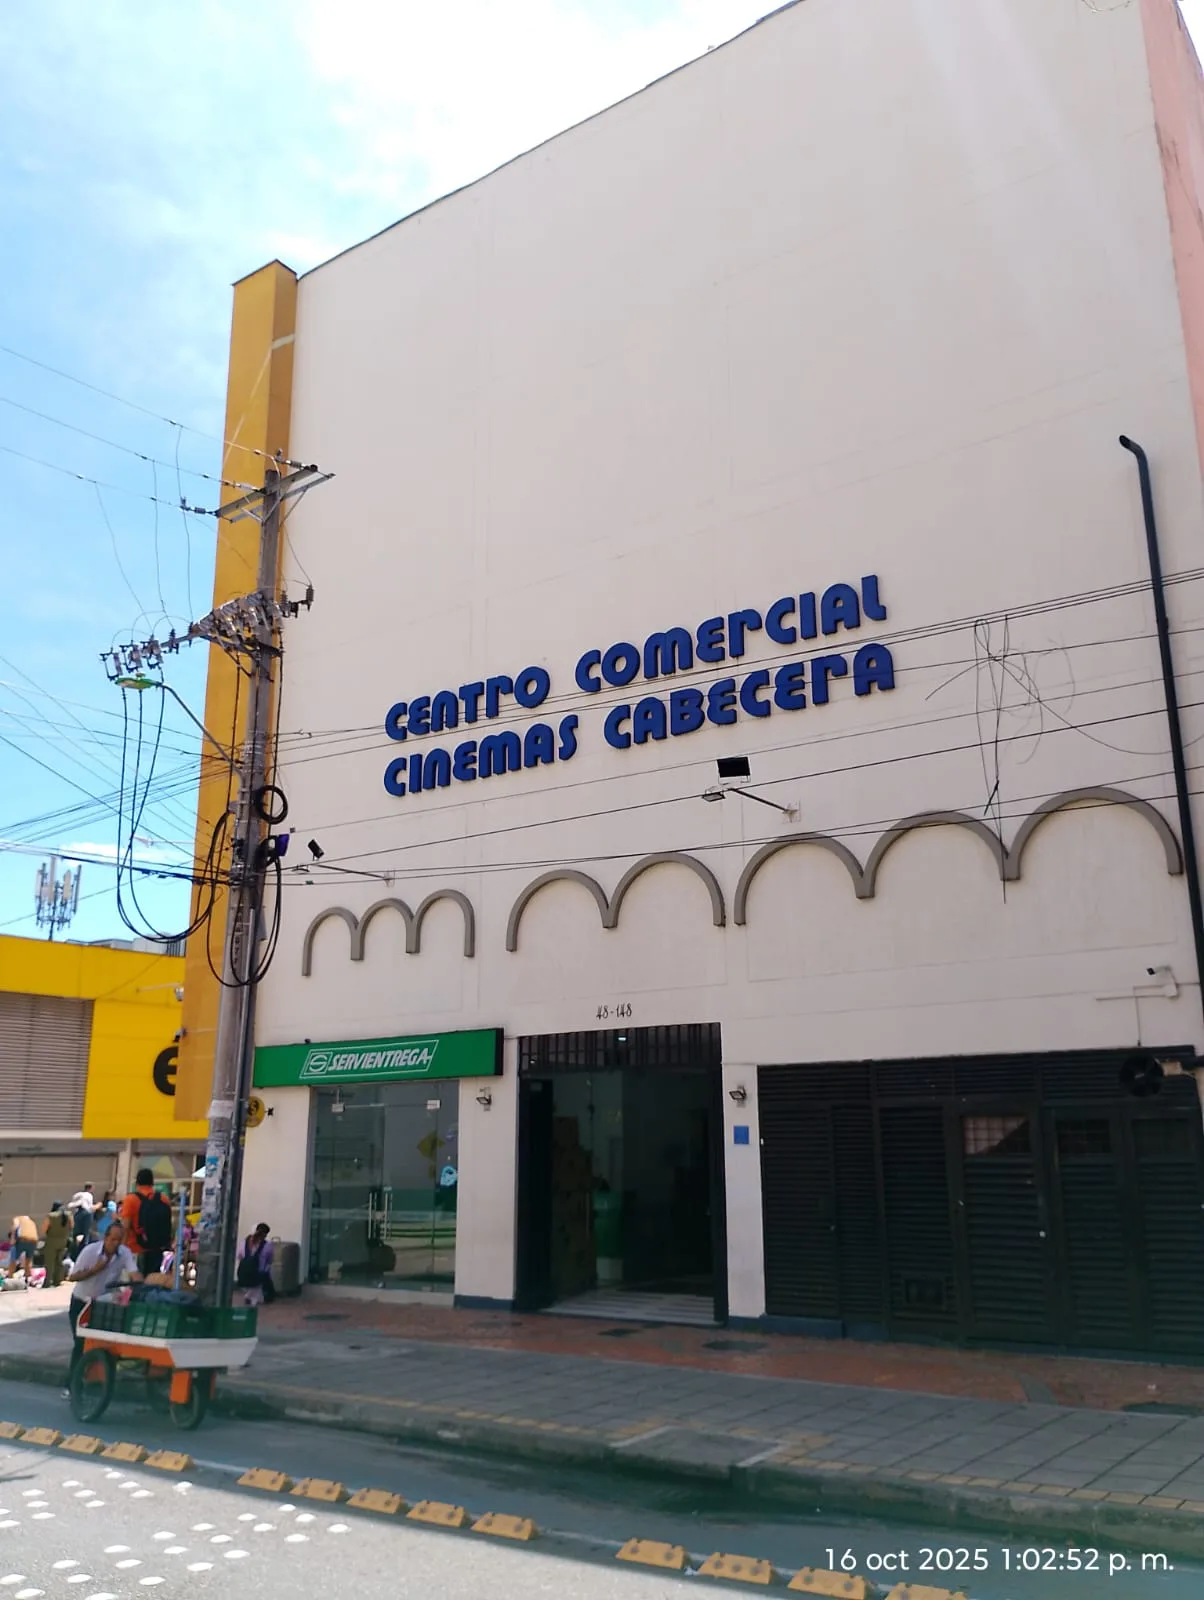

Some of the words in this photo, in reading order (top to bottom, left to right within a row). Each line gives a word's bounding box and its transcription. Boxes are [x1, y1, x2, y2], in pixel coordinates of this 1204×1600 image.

[384, 666, 549, 741] CENTRO
[575, 575, 886, 692] COMERCIAL
[384, 715, 578, 797] CINEMAS
[604, 644, 894, 748] CABECERA
[328, 1048, 433, 1071] SERVIENTREGA
